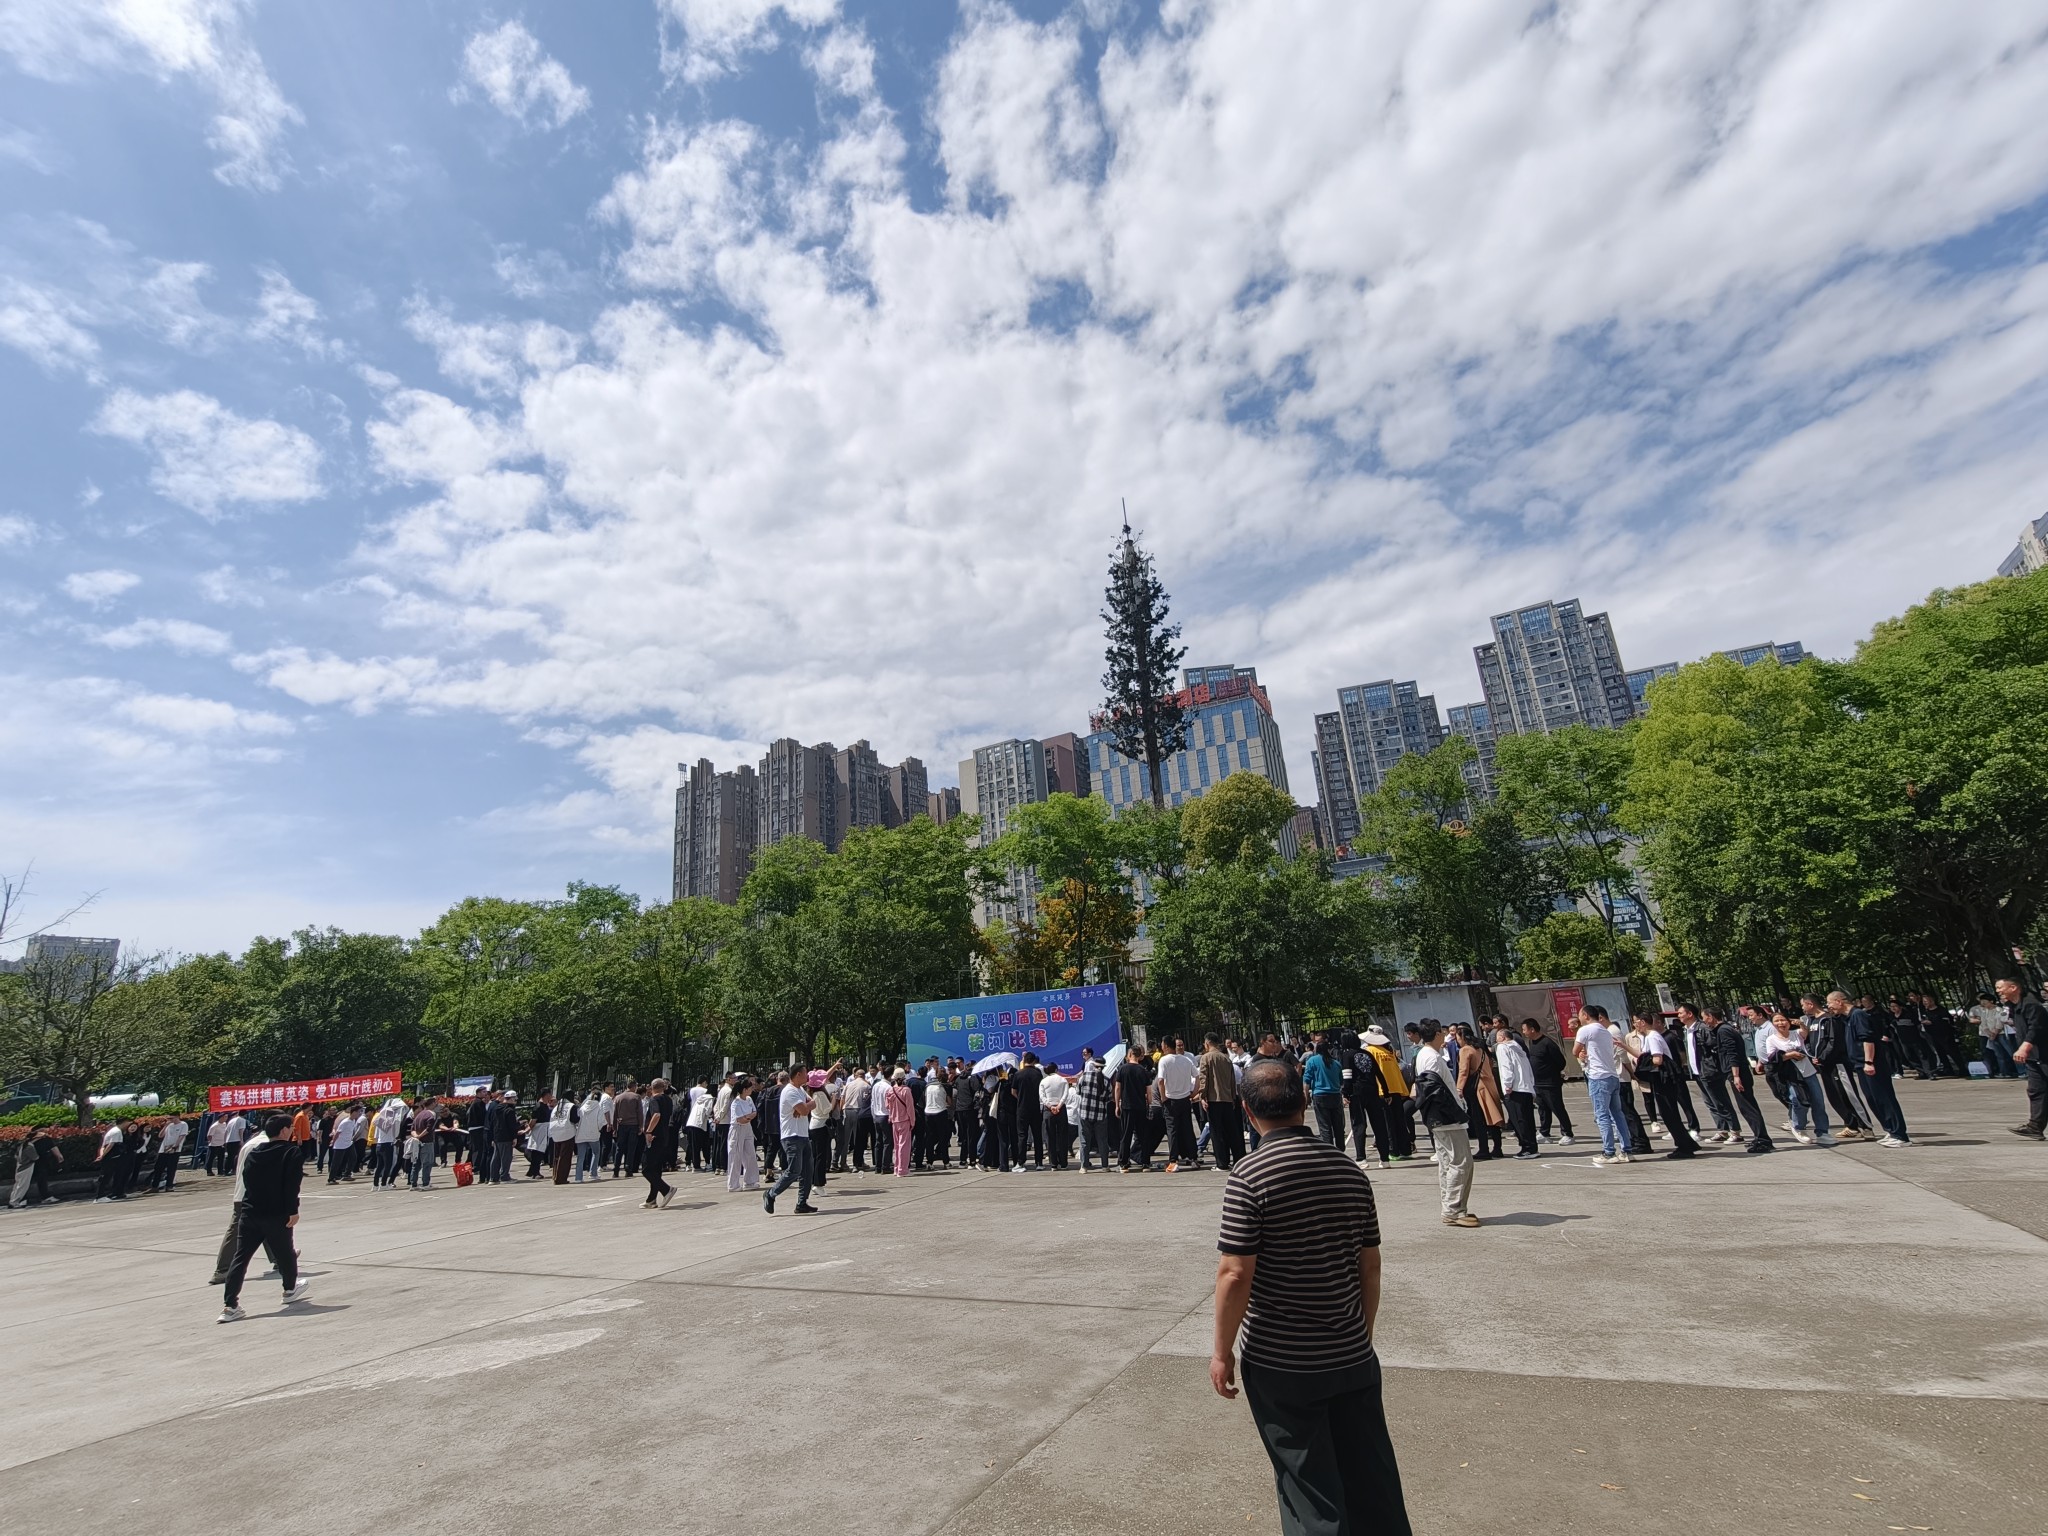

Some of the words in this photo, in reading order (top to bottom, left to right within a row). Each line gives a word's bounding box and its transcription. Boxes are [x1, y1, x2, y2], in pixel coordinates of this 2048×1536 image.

[932, 1004, 1084, 1032] 仁寿县第四届运动会
[968, 1028, 1047, 1052] 拔河比赛
[219, 1085, 309, 1107] 赛场拼搏展英姿
[315, 1077, 393, 1099] 爱卫同行践初心
